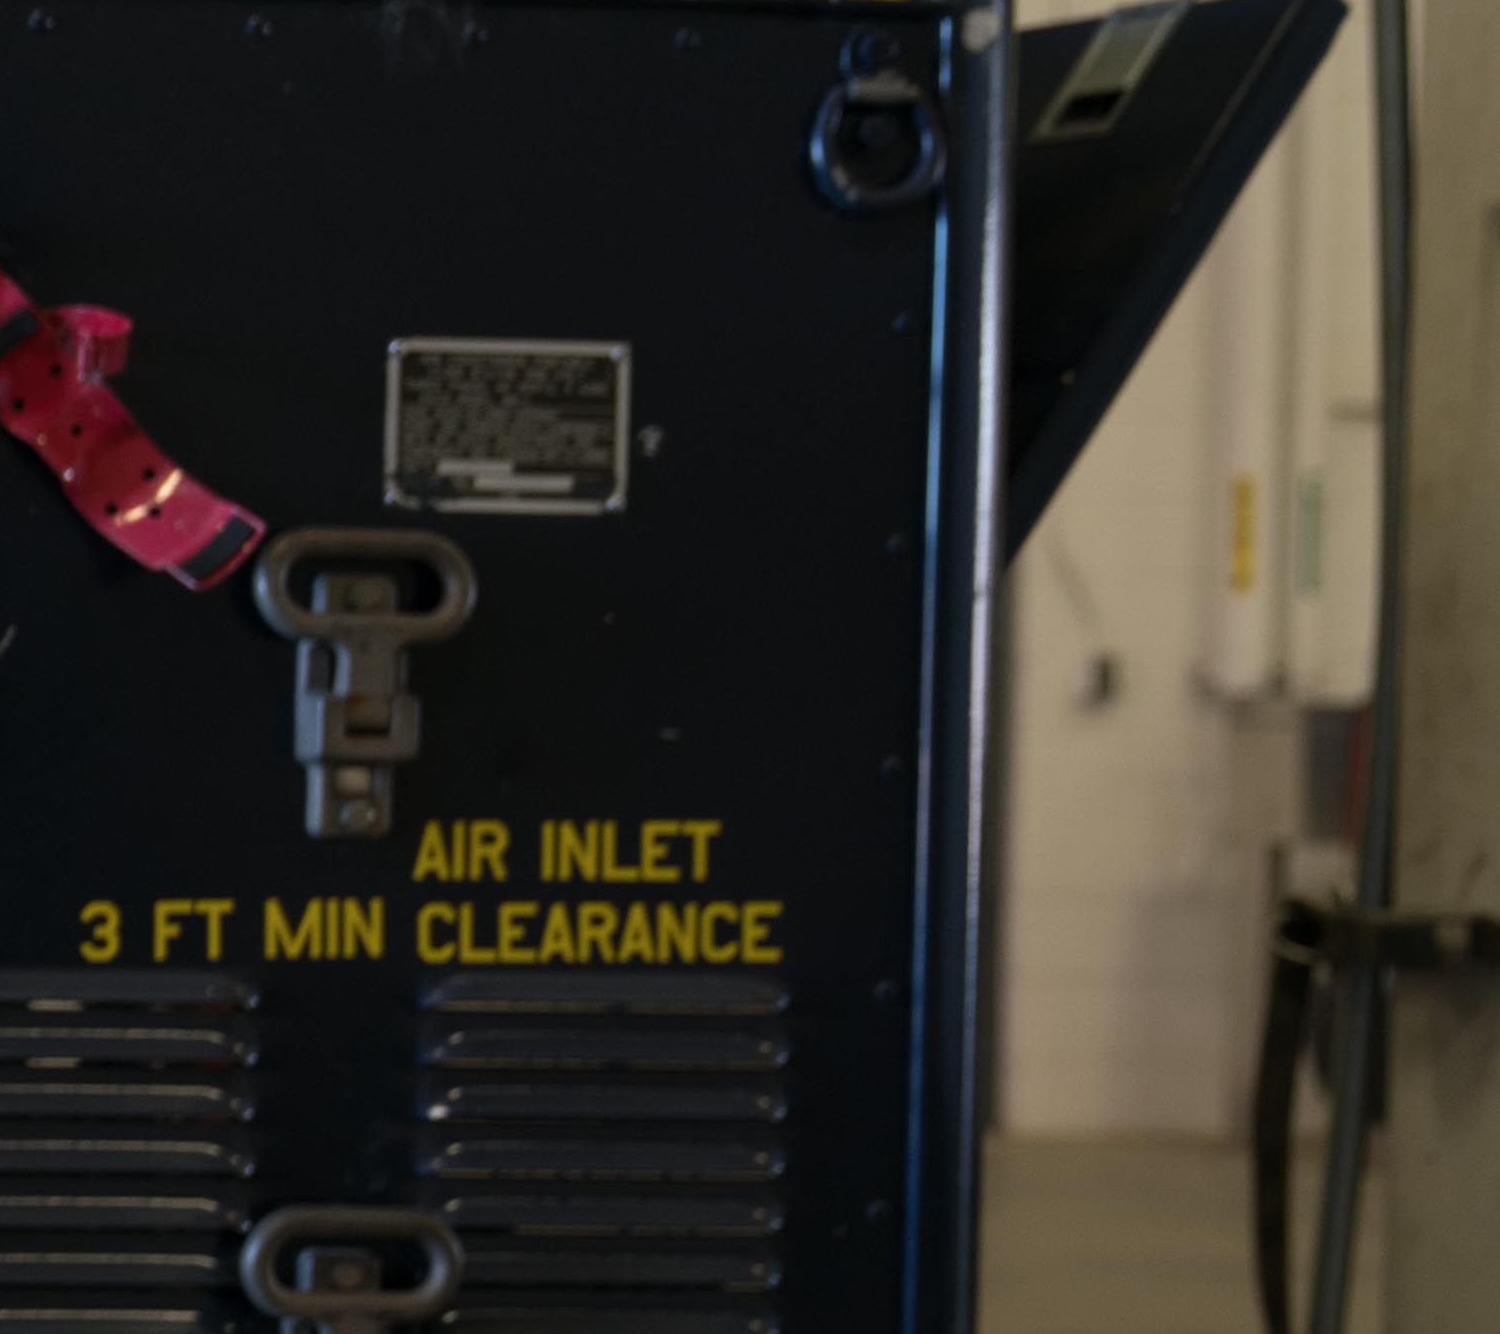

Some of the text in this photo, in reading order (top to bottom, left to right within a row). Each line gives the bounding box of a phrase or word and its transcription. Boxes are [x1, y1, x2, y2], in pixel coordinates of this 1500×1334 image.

[413, 819, 722, 883] AIR INLET
[79, 897, 783, 964] 3 FT MIN CLEARANCE
